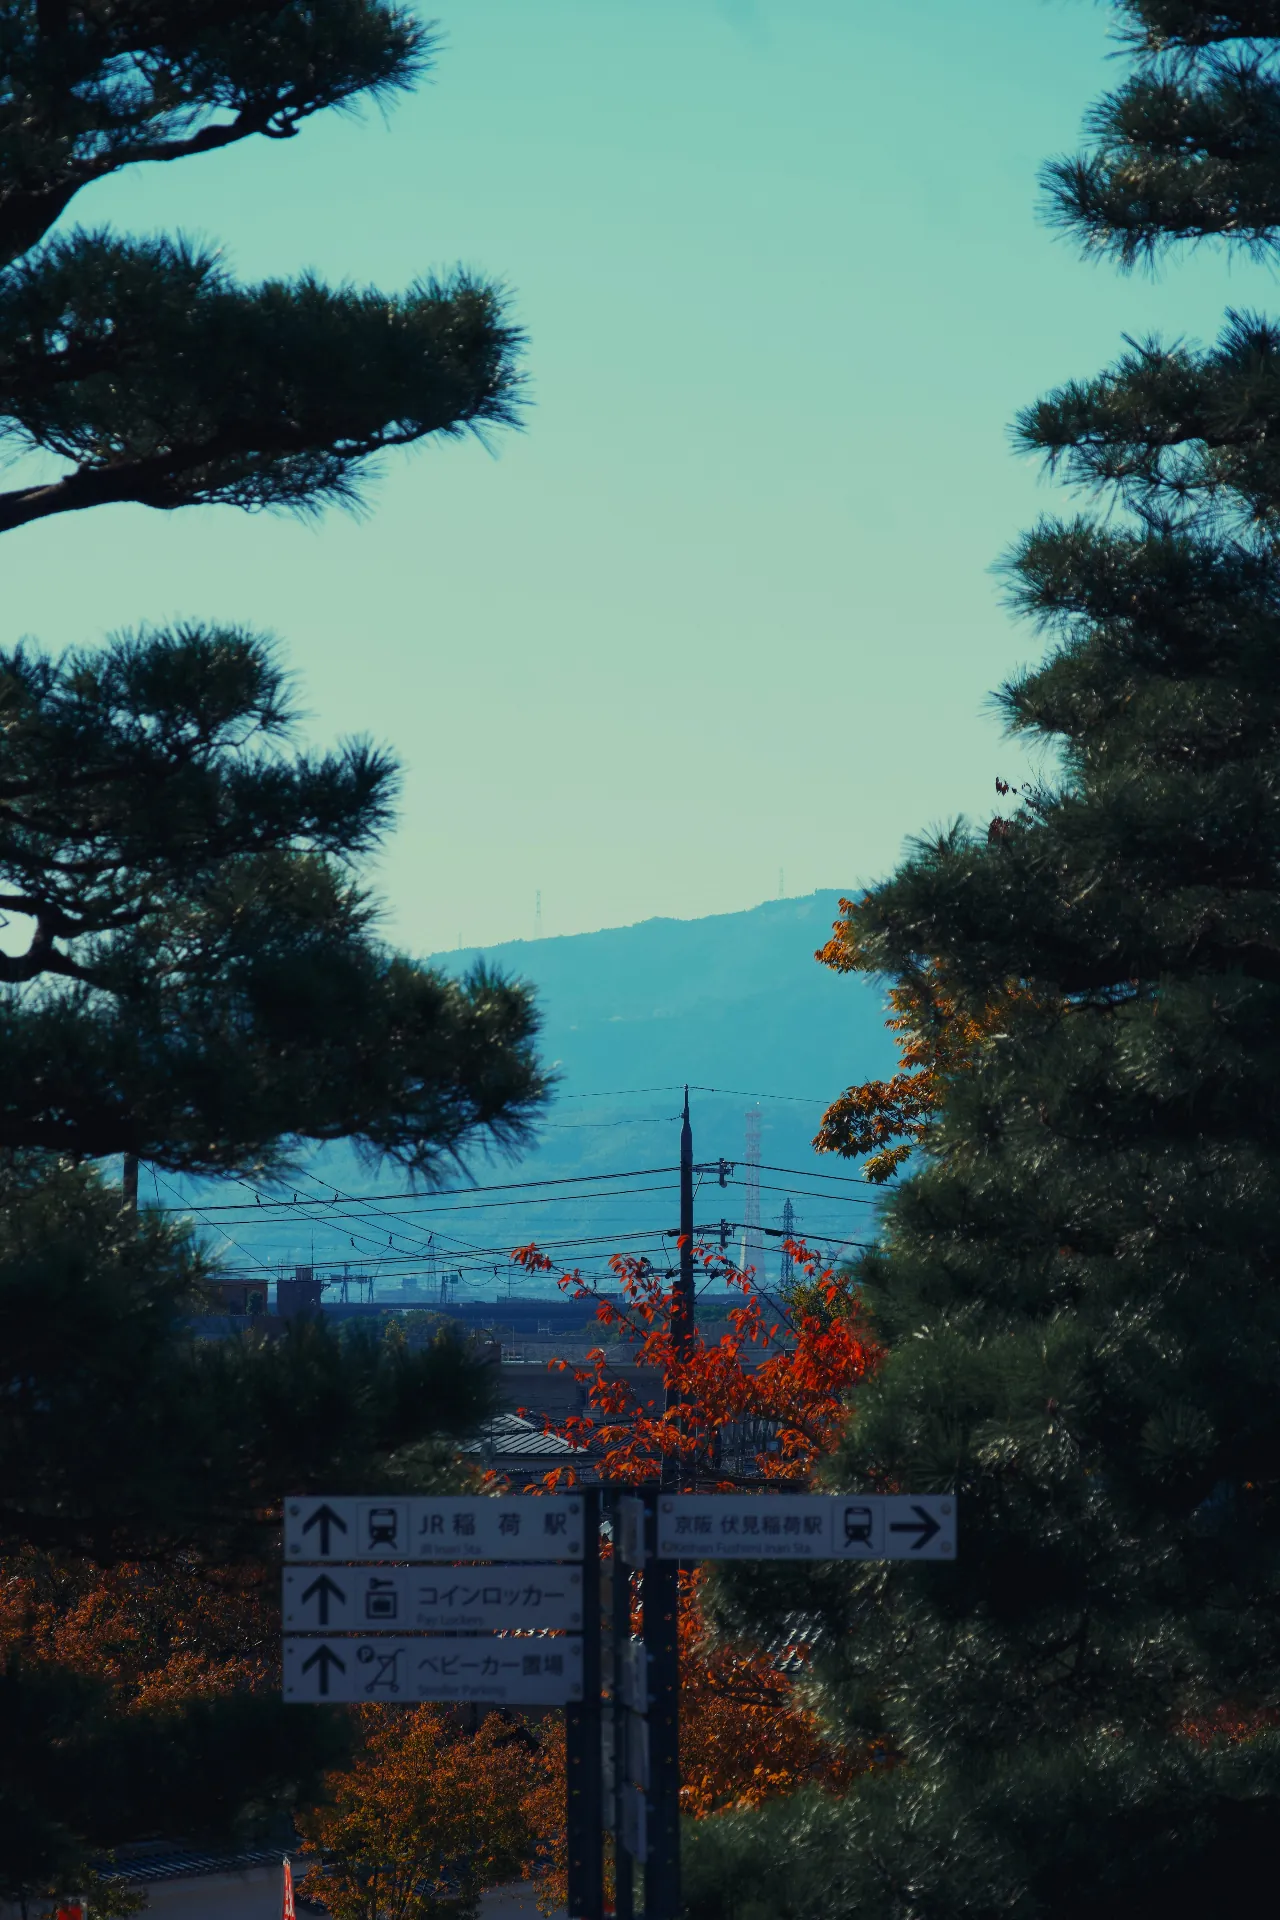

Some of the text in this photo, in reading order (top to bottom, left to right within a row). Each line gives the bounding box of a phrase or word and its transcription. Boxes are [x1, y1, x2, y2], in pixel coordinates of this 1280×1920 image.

[419, 1584, 565, 1606] コインロッカー
